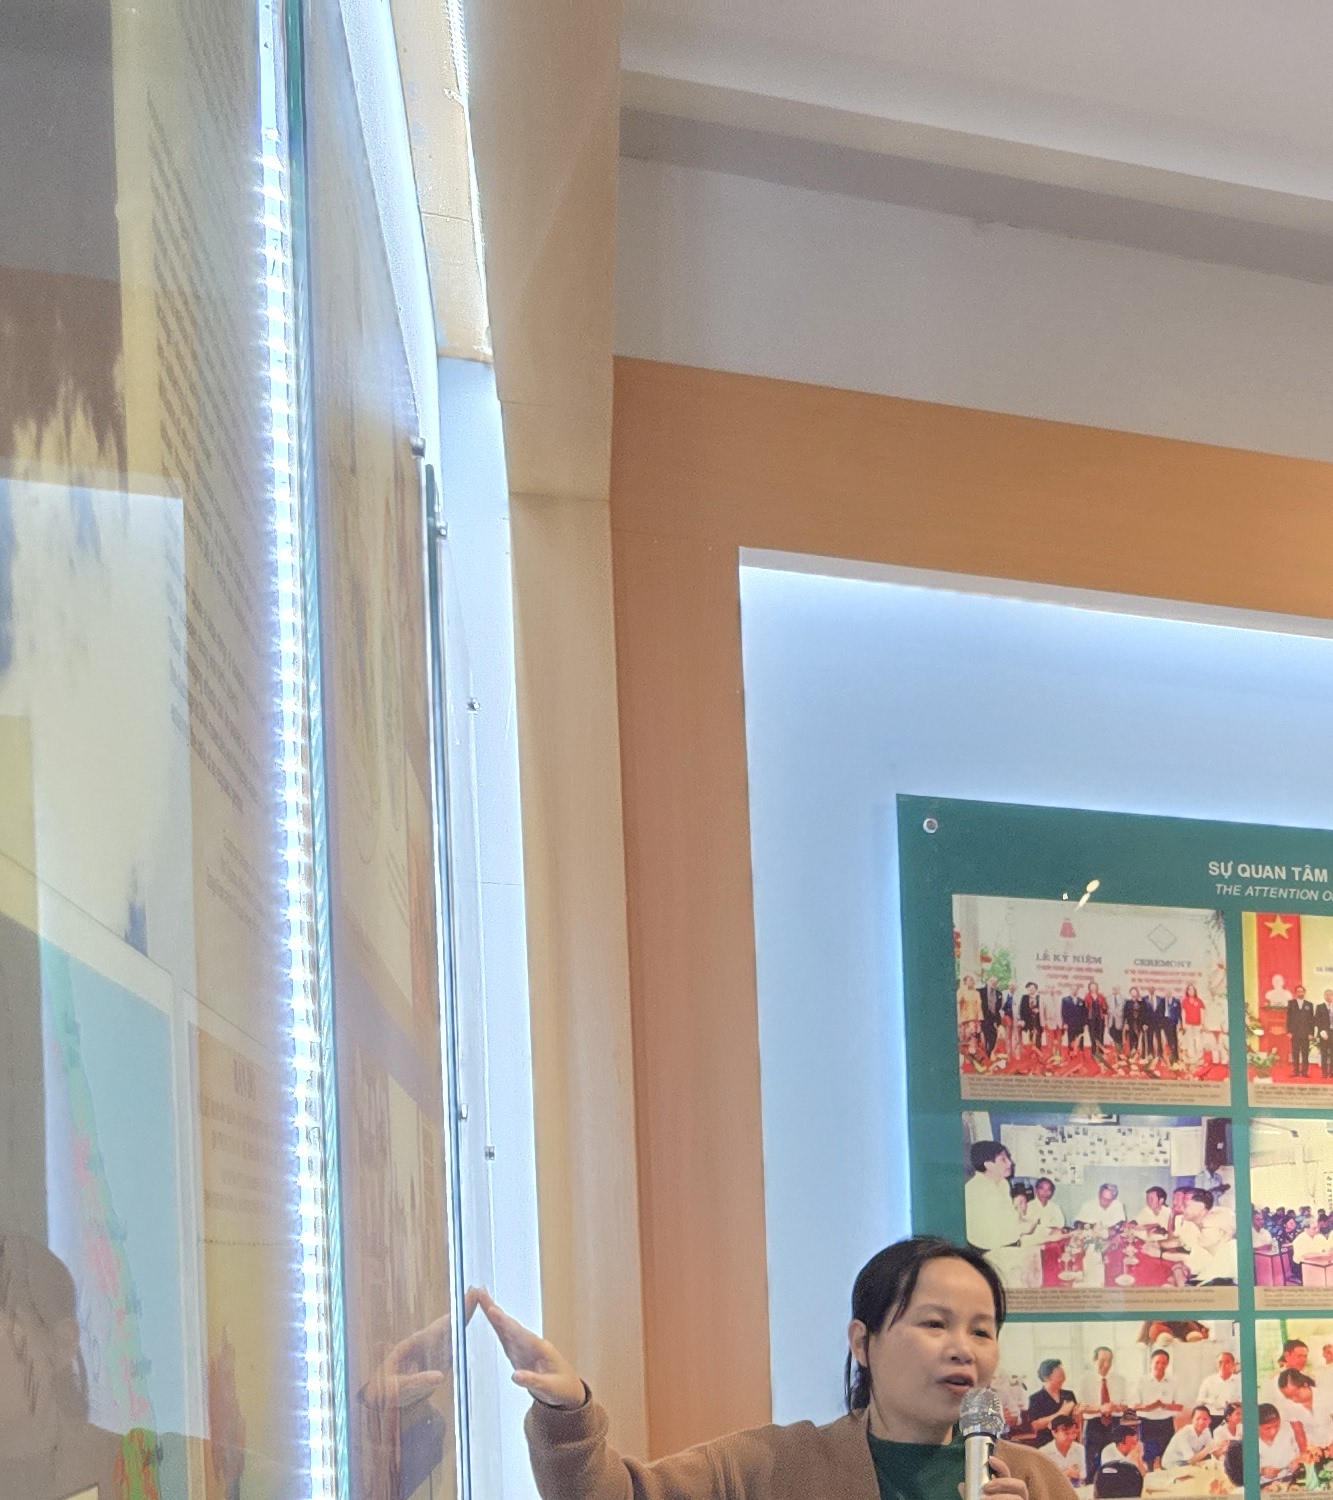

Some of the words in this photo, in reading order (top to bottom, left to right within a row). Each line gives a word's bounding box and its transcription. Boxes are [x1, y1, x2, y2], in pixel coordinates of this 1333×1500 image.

[1208, 860, 1234, 879] SỰ
[1237, 863, 1286, 880] QUAN
[1291, 864, 1328, 882] TÂM
[1215, 884, 1241, 896] THE
[1244, 886, 1318, 901] ATTENTION
